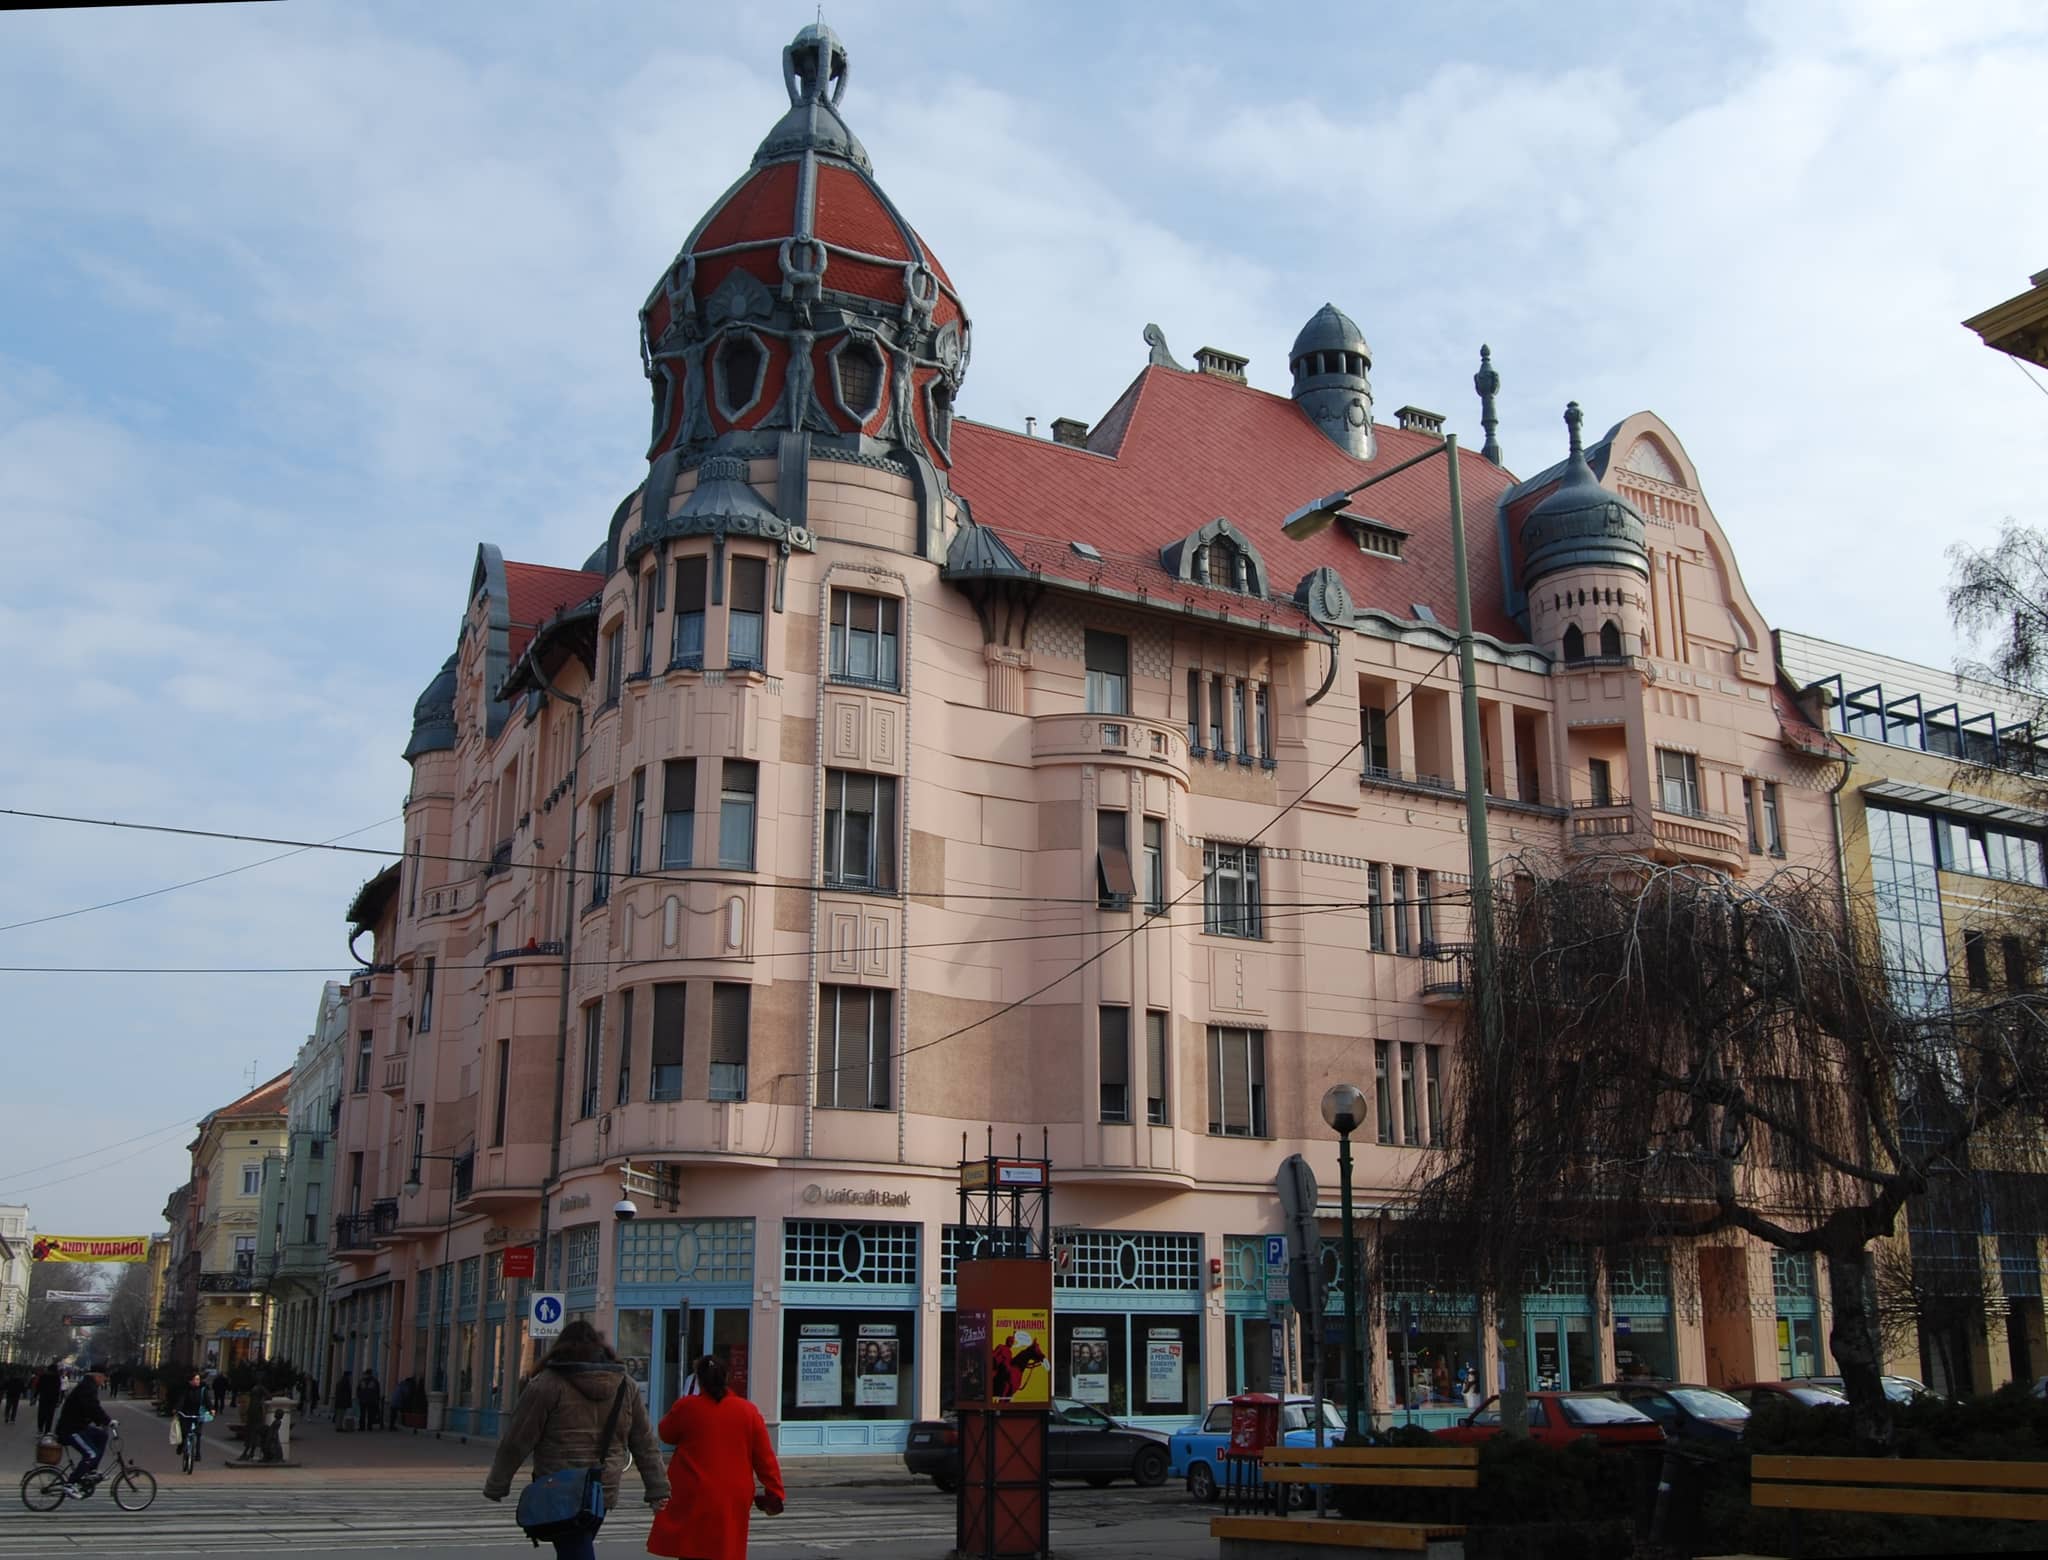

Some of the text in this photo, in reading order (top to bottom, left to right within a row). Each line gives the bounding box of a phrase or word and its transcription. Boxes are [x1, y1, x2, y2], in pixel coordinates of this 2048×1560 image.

[825, 1187, 911, 1207] UniCredit Bank
[61, 1242, 145, 1256] ANDY WARHOL
[1014, 1319, 1045, 1329] WARHOL
